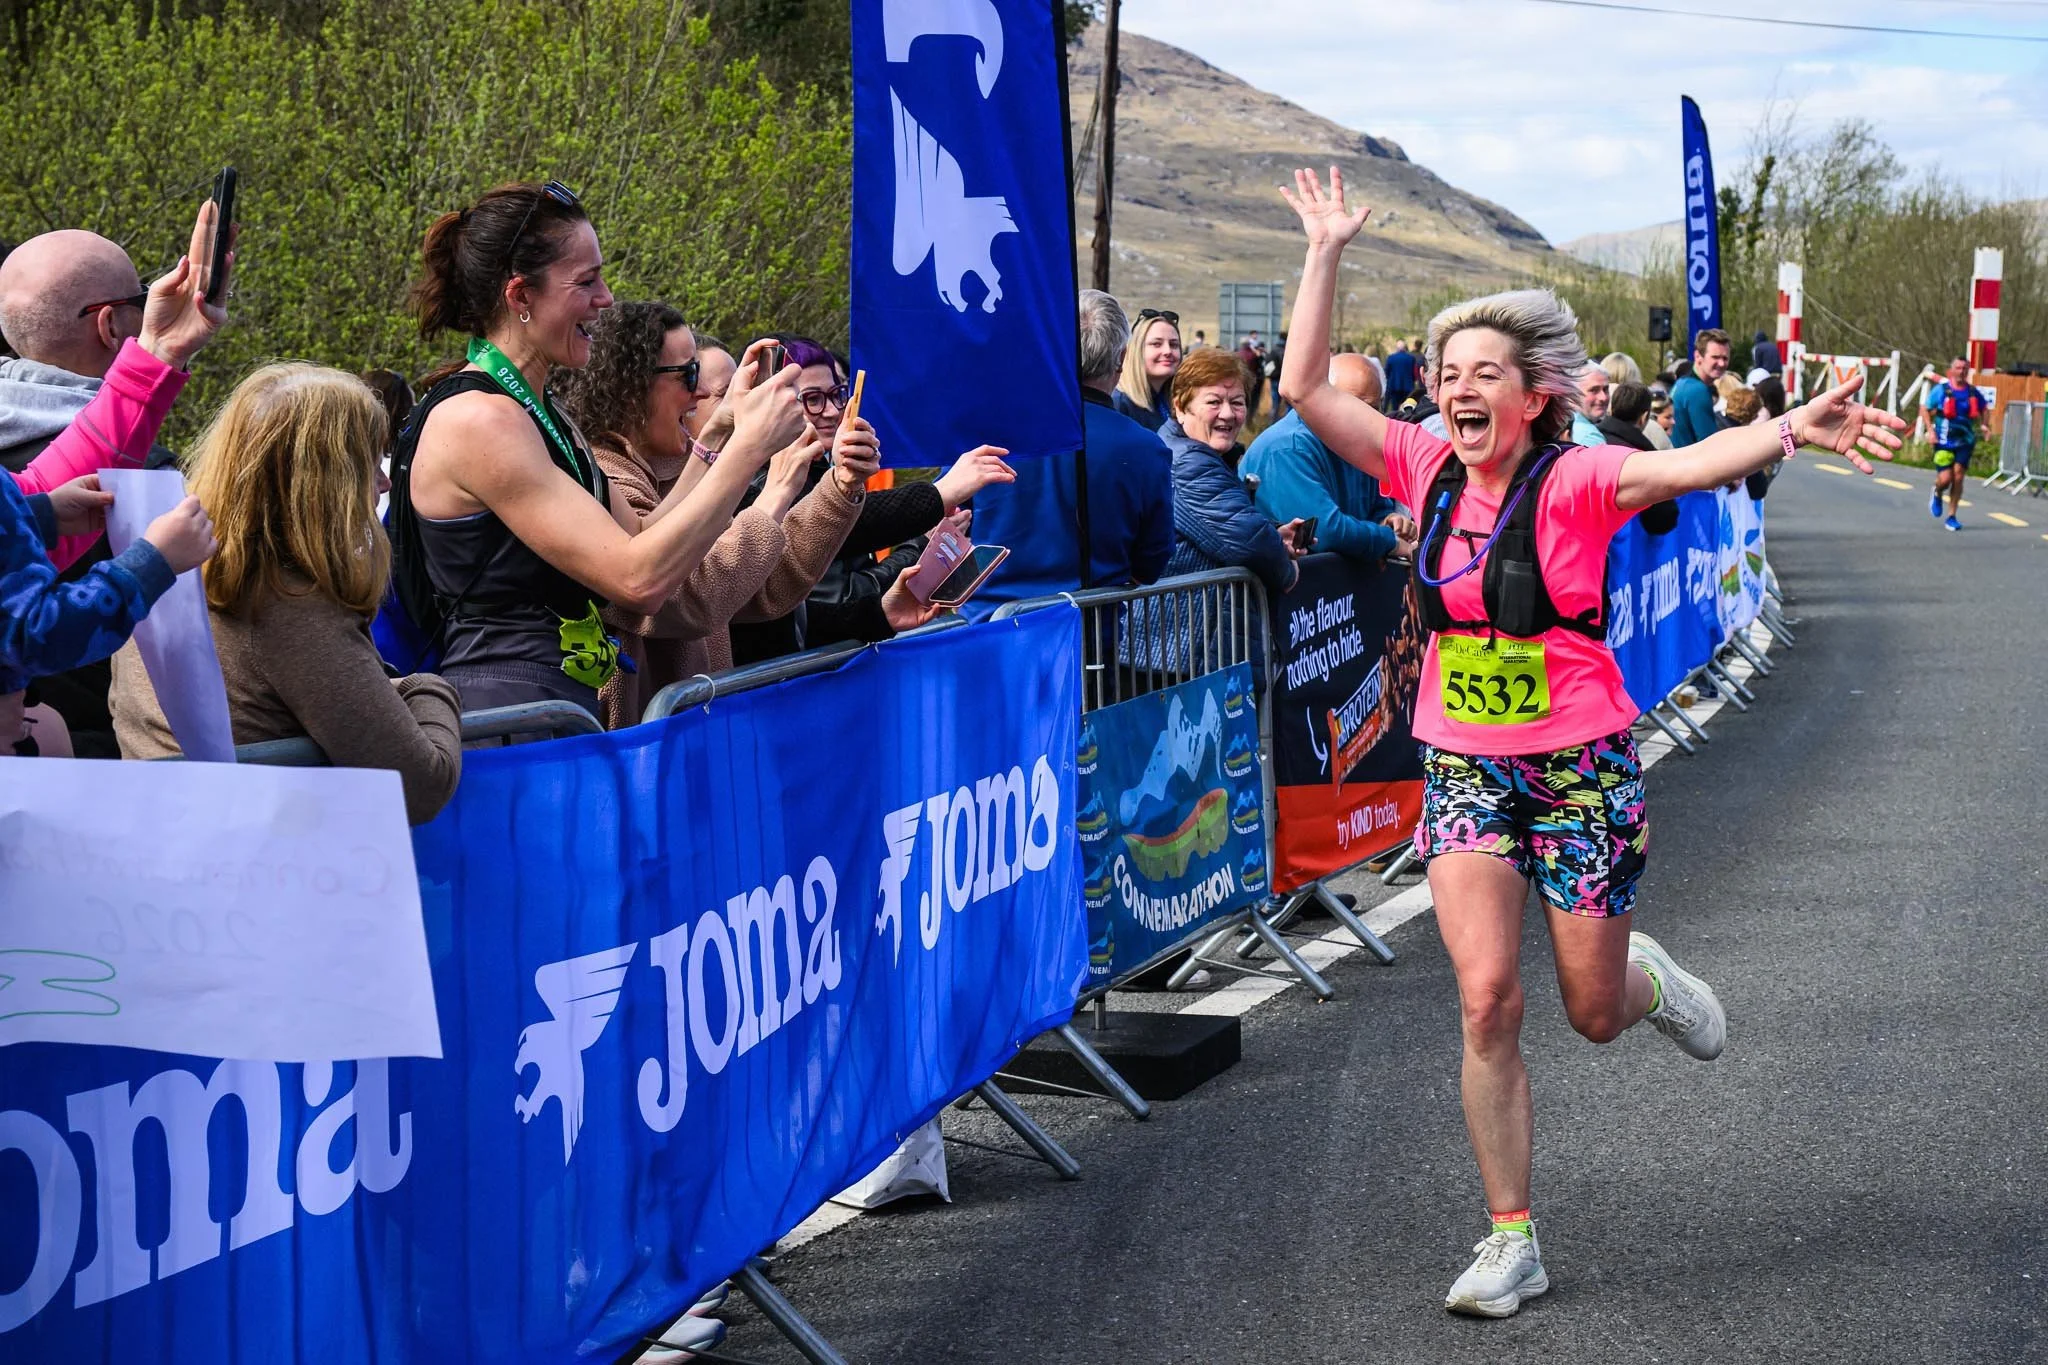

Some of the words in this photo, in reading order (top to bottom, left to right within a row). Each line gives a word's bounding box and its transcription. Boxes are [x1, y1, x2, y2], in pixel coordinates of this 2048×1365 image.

[497, 367, 525, 396] 2026
[1289, 610, 1300, 649] all
[1299, 606, 1316, 642] the
[1316, 593, 1355, 633] flavour.
[1287, 645, 1329, 691] nothing
[1327, 638, 1340, 668] to
[1339, 623, 1364, 663] hide.
[1343, 670, 1380, 740] PROTEIN
[1446, 670, 1540, 716] 5532
[919, 753, 1060, 951] Joma
[1337, 819, 1350, 851] try
[1350, 805, 1373, 840] KIND
[1374, 797, 1401, 829] today.
[1113, 854, 1236, 932] CONNEMARATHON
[636, 855, 843, 1134] Joma
[0, 1057, 413, 1336] oma
